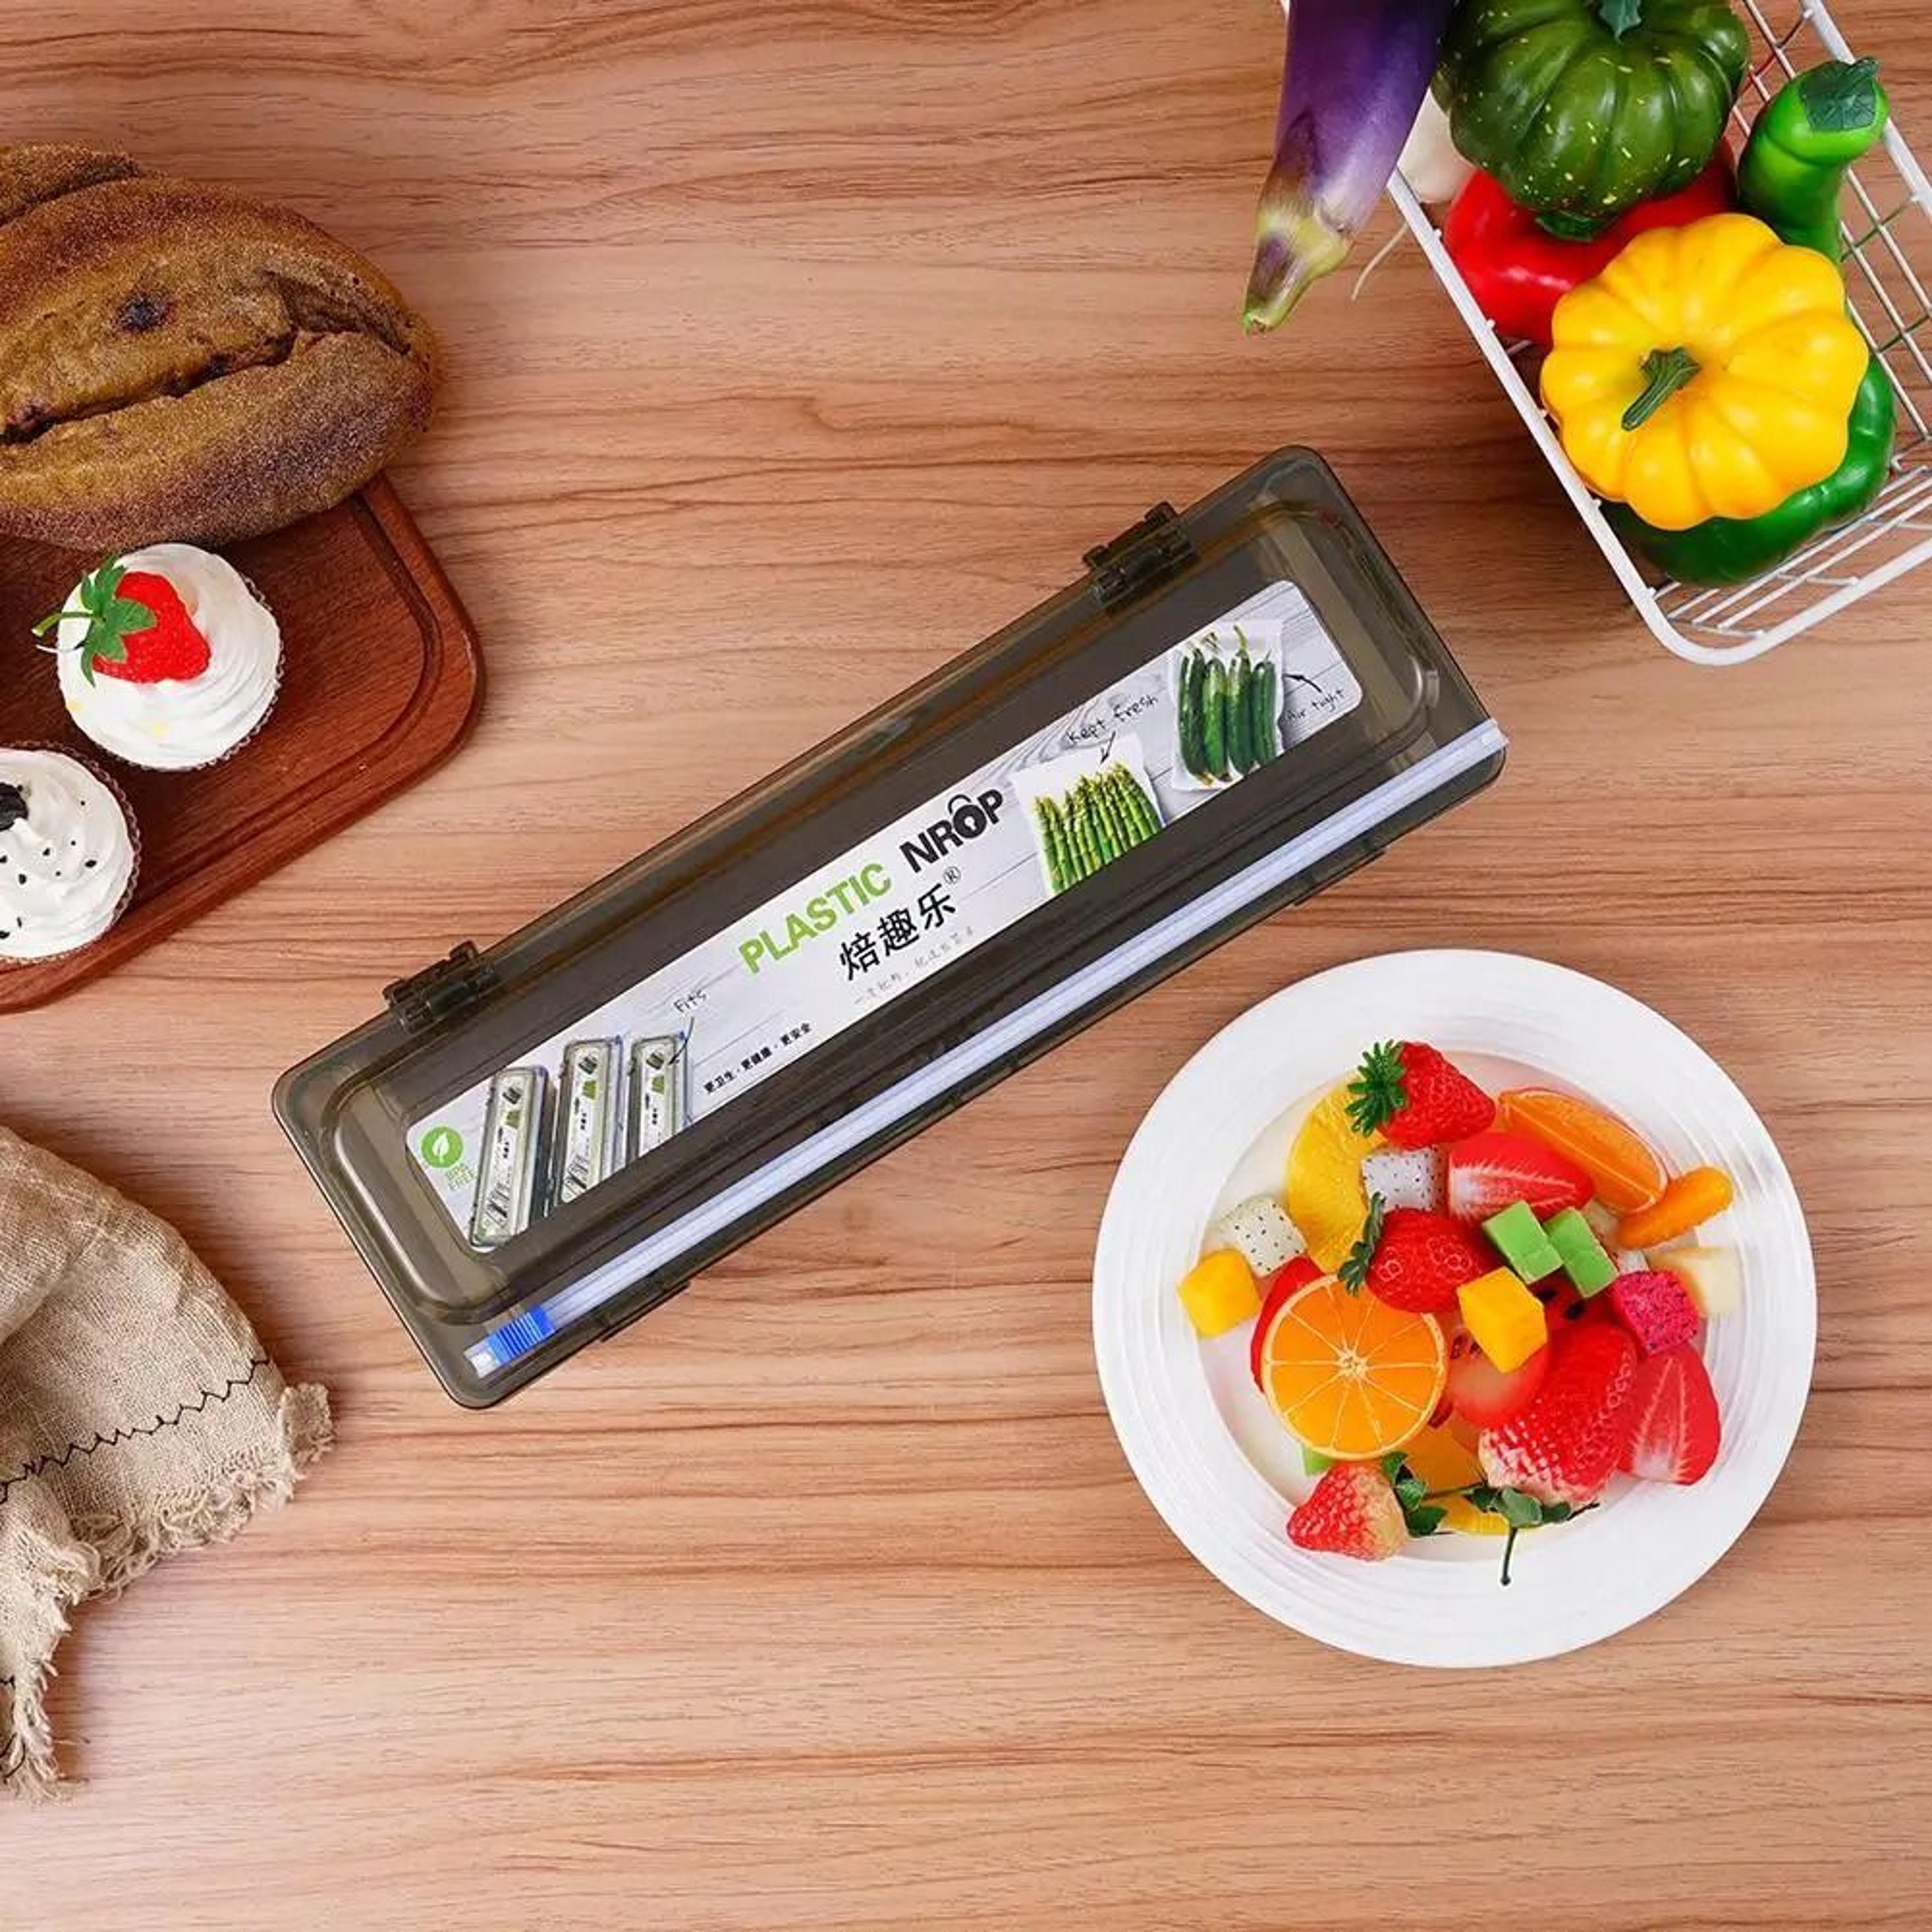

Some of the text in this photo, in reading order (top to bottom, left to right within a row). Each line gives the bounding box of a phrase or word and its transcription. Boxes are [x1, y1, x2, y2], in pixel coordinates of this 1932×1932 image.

[738, 862, 892, 975] PLASTIC
[899, 788, 1004, 873] NROP
[674, 989, 706, 1013] Fits
